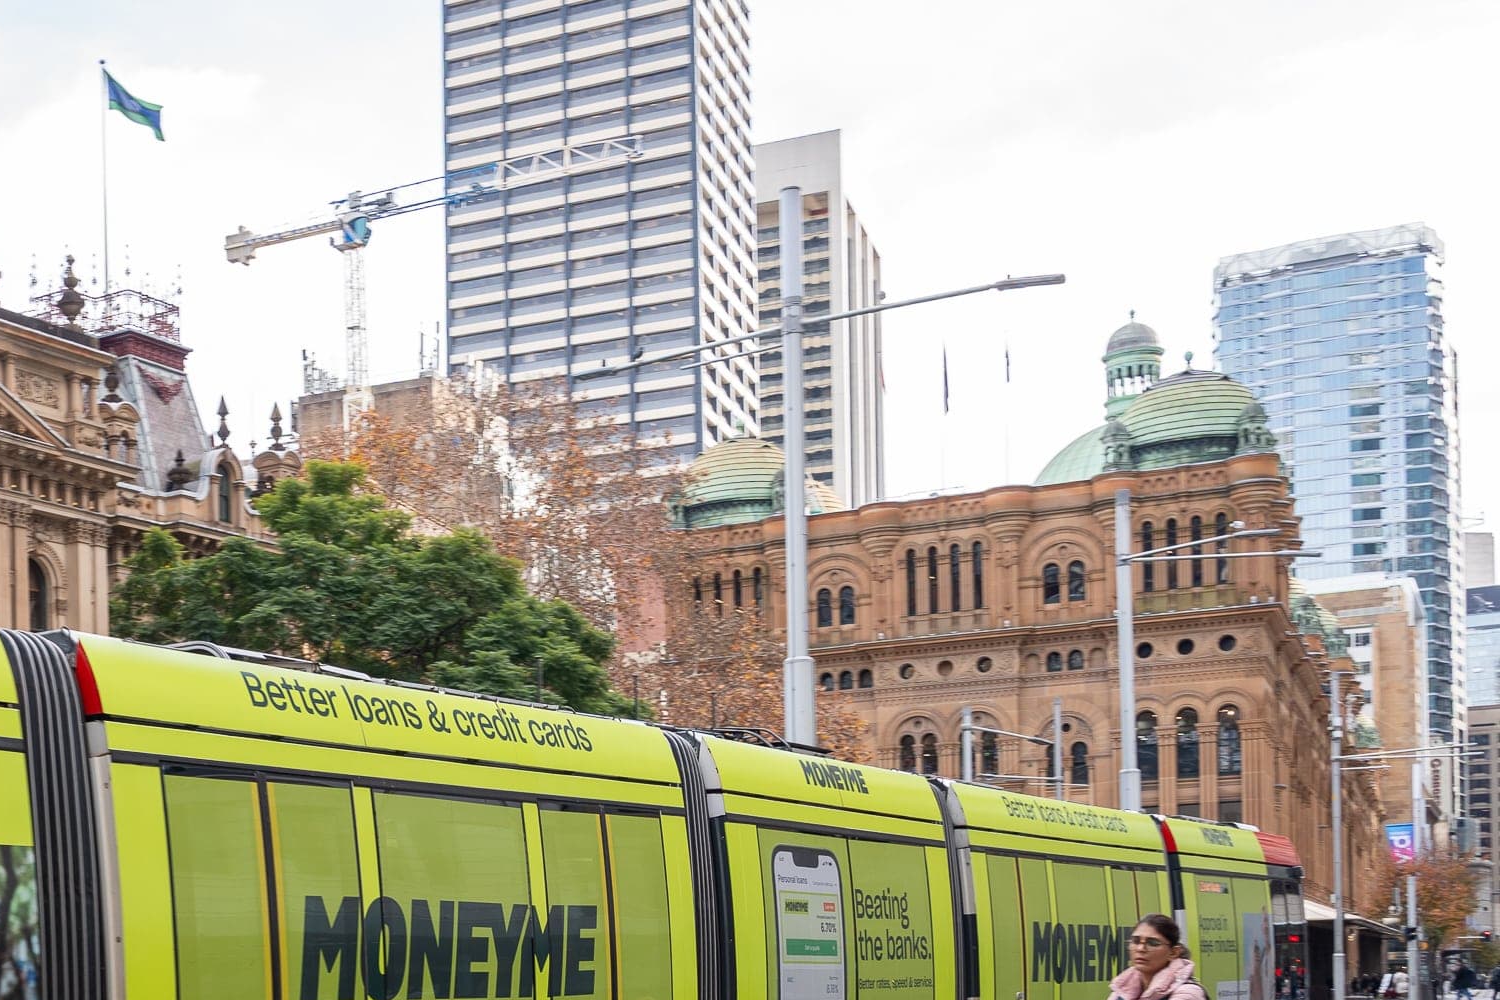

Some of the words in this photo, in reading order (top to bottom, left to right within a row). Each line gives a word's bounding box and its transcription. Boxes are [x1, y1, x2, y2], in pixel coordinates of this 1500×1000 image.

[240, 670, 338, 718] Better
[341, 684, 424, 731] loans
[427, 699, 451, 734] &
[452, 701, 528, 744] credit
[528, 718, 593, 752] cards
[798, 760, 869, 794] MONEYME
[854, 888, 910, 930] Beating
[858, 928, 883, 961] the
[886, 928, 932, 961] banks.
